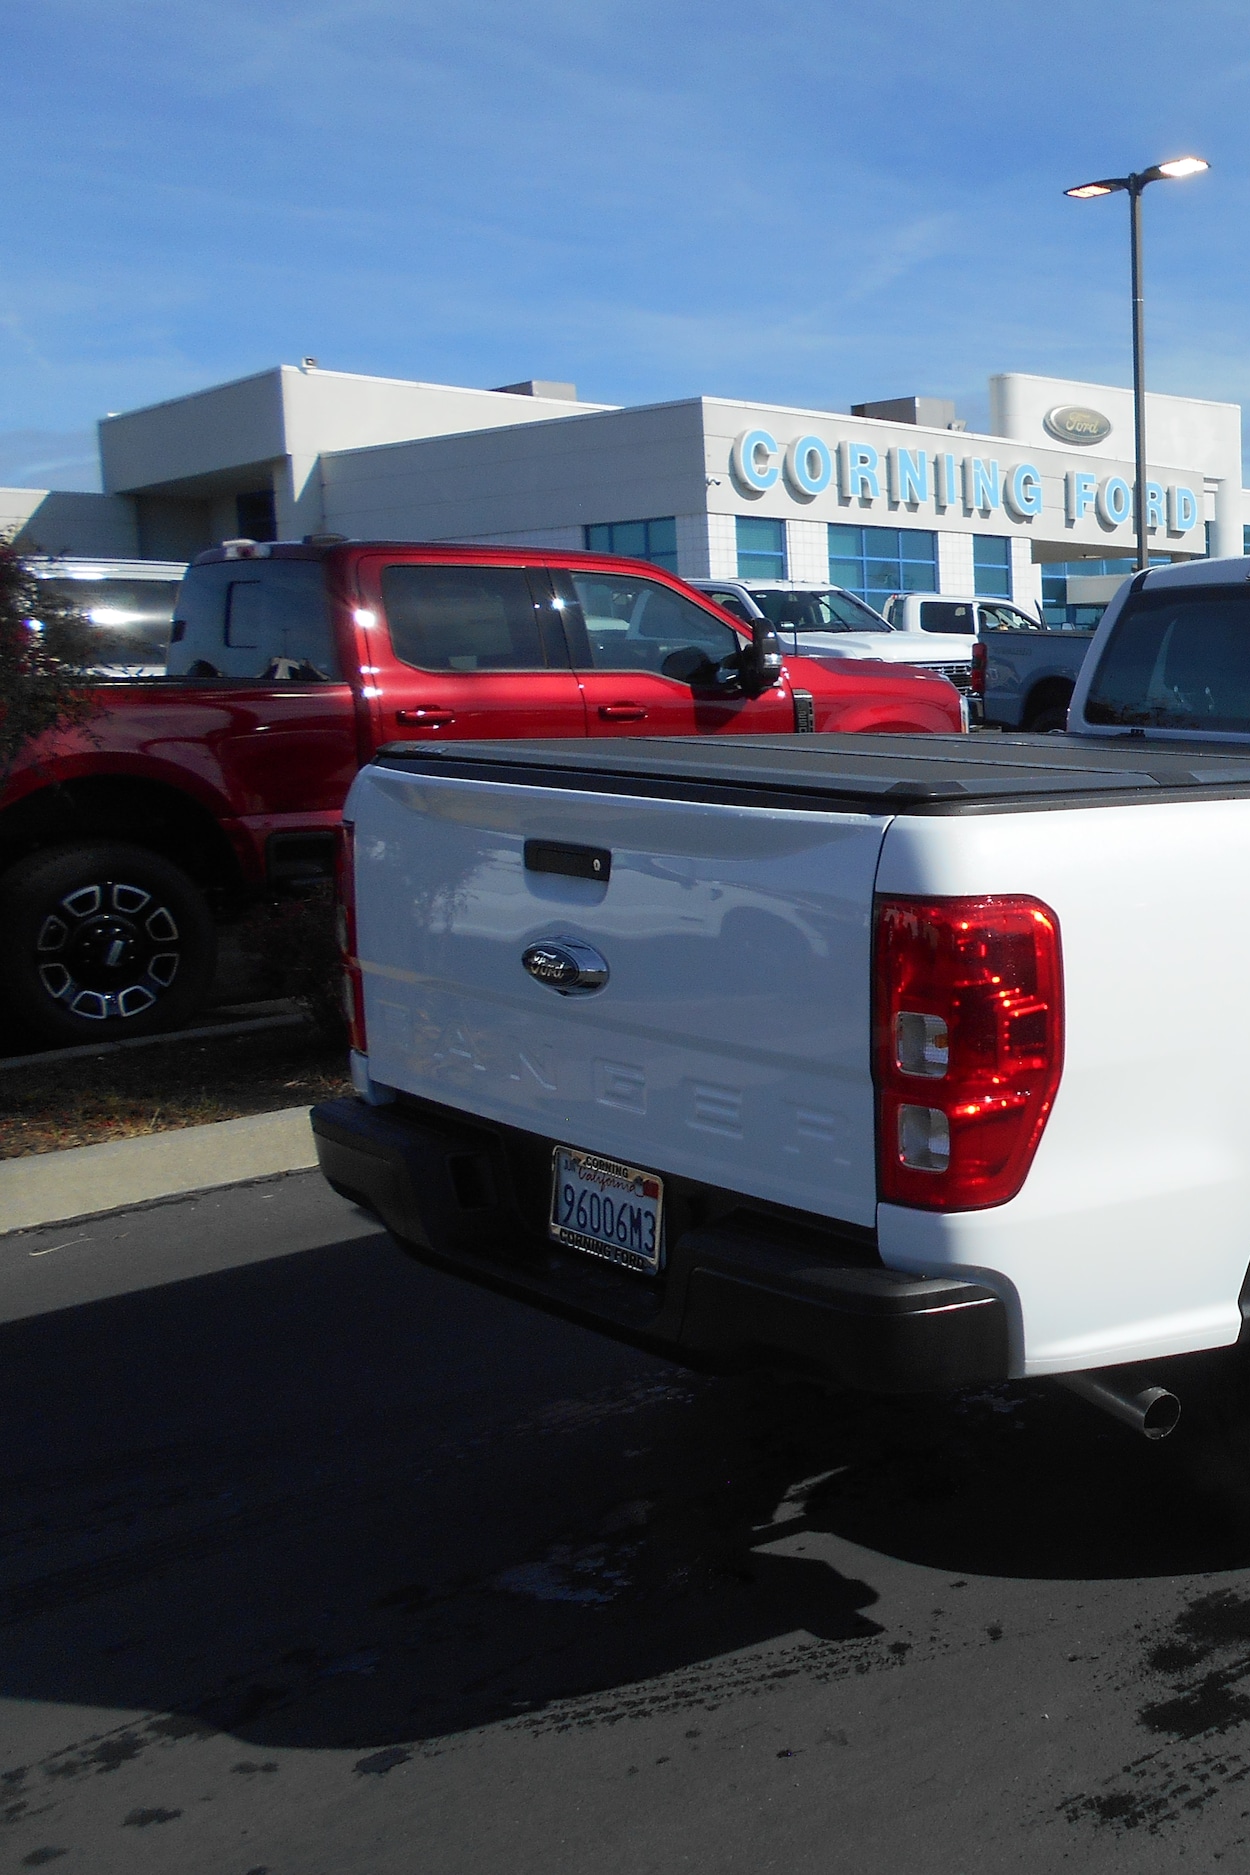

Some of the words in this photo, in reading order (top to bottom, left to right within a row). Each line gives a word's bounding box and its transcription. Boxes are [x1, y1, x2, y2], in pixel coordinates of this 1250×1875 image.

[1066, 411, 1099, 434] Ford
[733, 427, 1043, 518] CORNING
[1067, 470, 1198, 533] FORD
[584, 1155, 629, 1178] CORNING
[563, 1183, 657, 1252] 96006M3
[559, 1228, 611, 1258] CORNING
[614, 1249, 645, 1270] FORD
